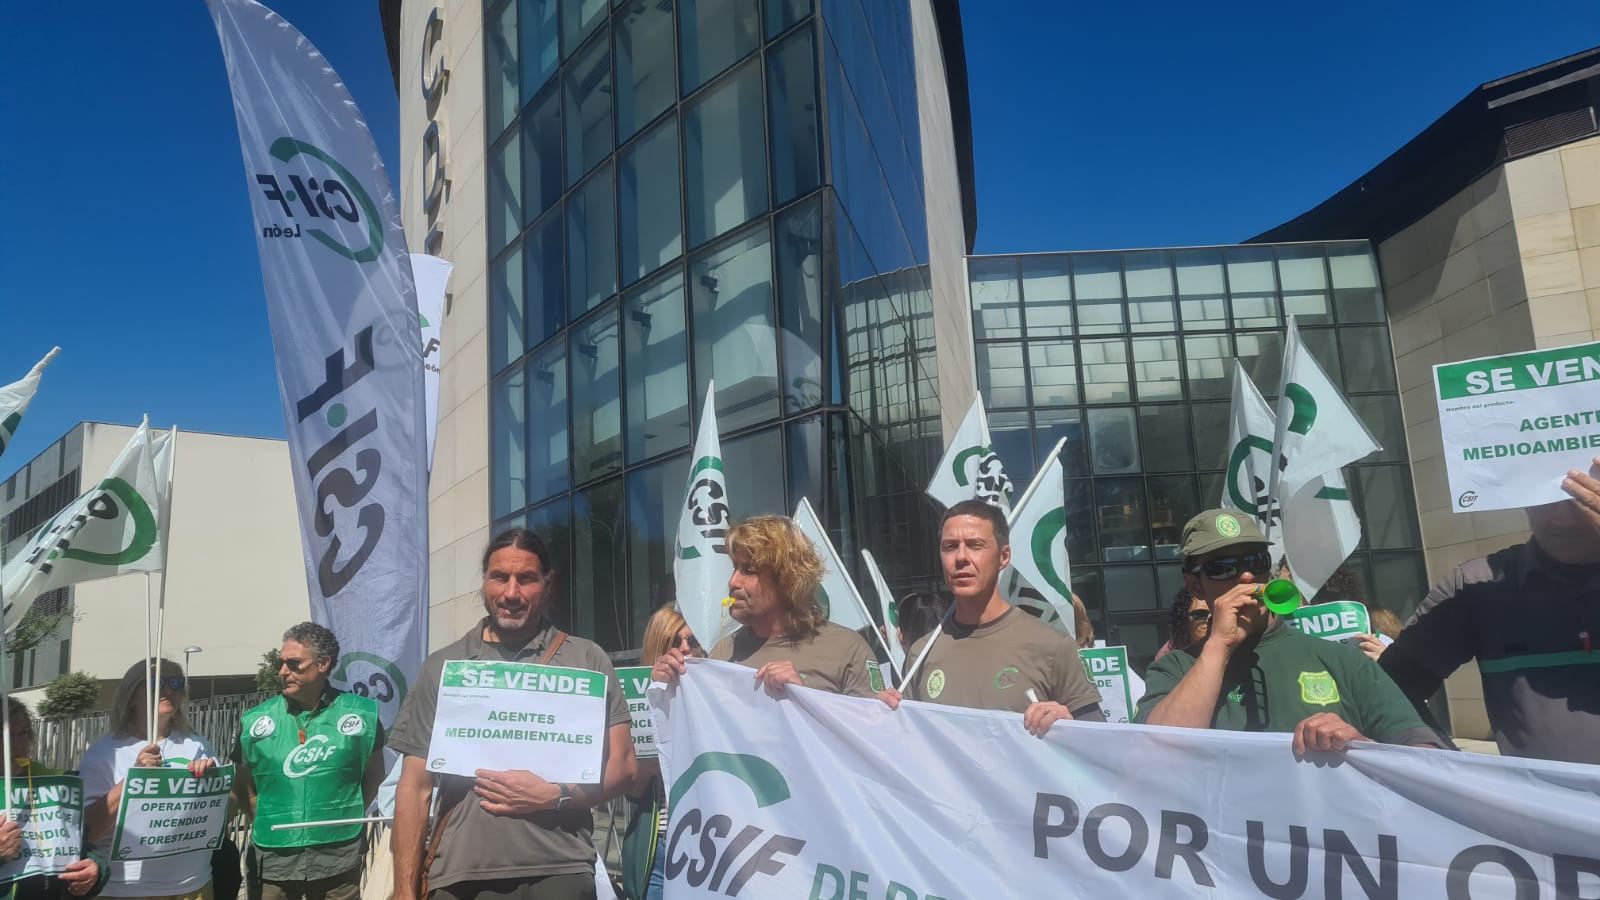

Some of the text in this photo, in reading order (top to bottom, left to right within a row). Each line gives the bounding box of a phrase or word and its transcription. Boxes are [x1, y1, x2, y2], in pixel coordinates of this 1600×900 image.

[1466, 367, 1515, 394] SE
[1294, 611, 1359, 634] NDE
[461, 669, 591, 695] SE VENDE
[488, 710, 555, 725] AGENTES
[445, 727, 593, 745] MEDIOAMBIENTALES
[127, 774, 231, 795] SE VENDE
[141, 799, 222, 812] OPERATIVO DE
[149, 815, 208, 828] INCENDIOS
[140, 830, 207, 845] FORESTALES
[1033, 792, 1216, 888] POR
[1246, 820, 1398, 900] UN
[665, 808, 807, 897] CSIF
[808, 863, 869, 900] DE
